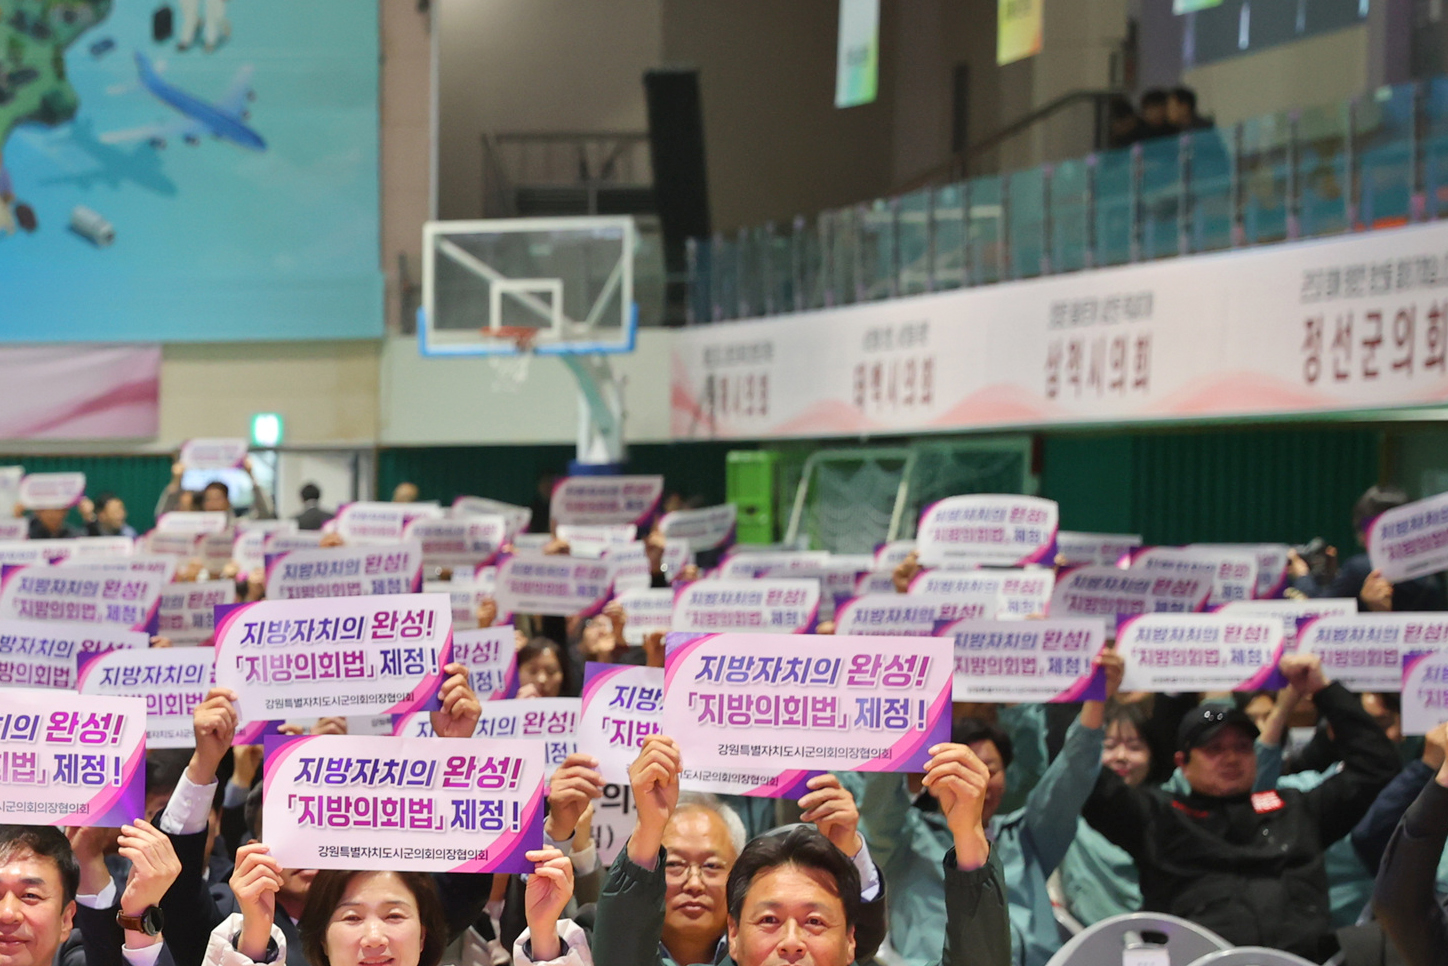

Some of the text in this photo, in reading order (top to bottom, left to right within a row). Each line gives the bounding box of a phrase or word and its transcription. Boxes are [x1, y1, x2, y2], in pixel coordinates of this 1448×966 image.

[1300, 299, 1448, 386] 정선군의회
[17, 577, 148, 598] 지방자치의 완성!
[240, 610, 435, 645] 지방자치의 완성!
[953, 629, 1092, 651] 지방자치의 완성!
[99, 664, 204, 687] 지방자치의
[236, 652, 376, 683] 「지방의회법」
[695, 653, 931, 687] 지방자치의 완성!
[265, 692, 415, 710] 강원특별자치도시군의회의장협의회
[689, 692, 848, 729] 「지방의회법」
[45, 710, 124, 745] 완성!
[415, 714, 517, 738] 지치의
[522, 711, 577, 736] 완성!
[718, 743, 893, 761] 강원특별자치도시군의회의장협의회
[294, 756, 524, 789] 지방자치의 완성!
[287, 793, 445, 831] 「지방의회법」
[318, 844, 489, 862] 강원특별자치도시군의회의장협의회
